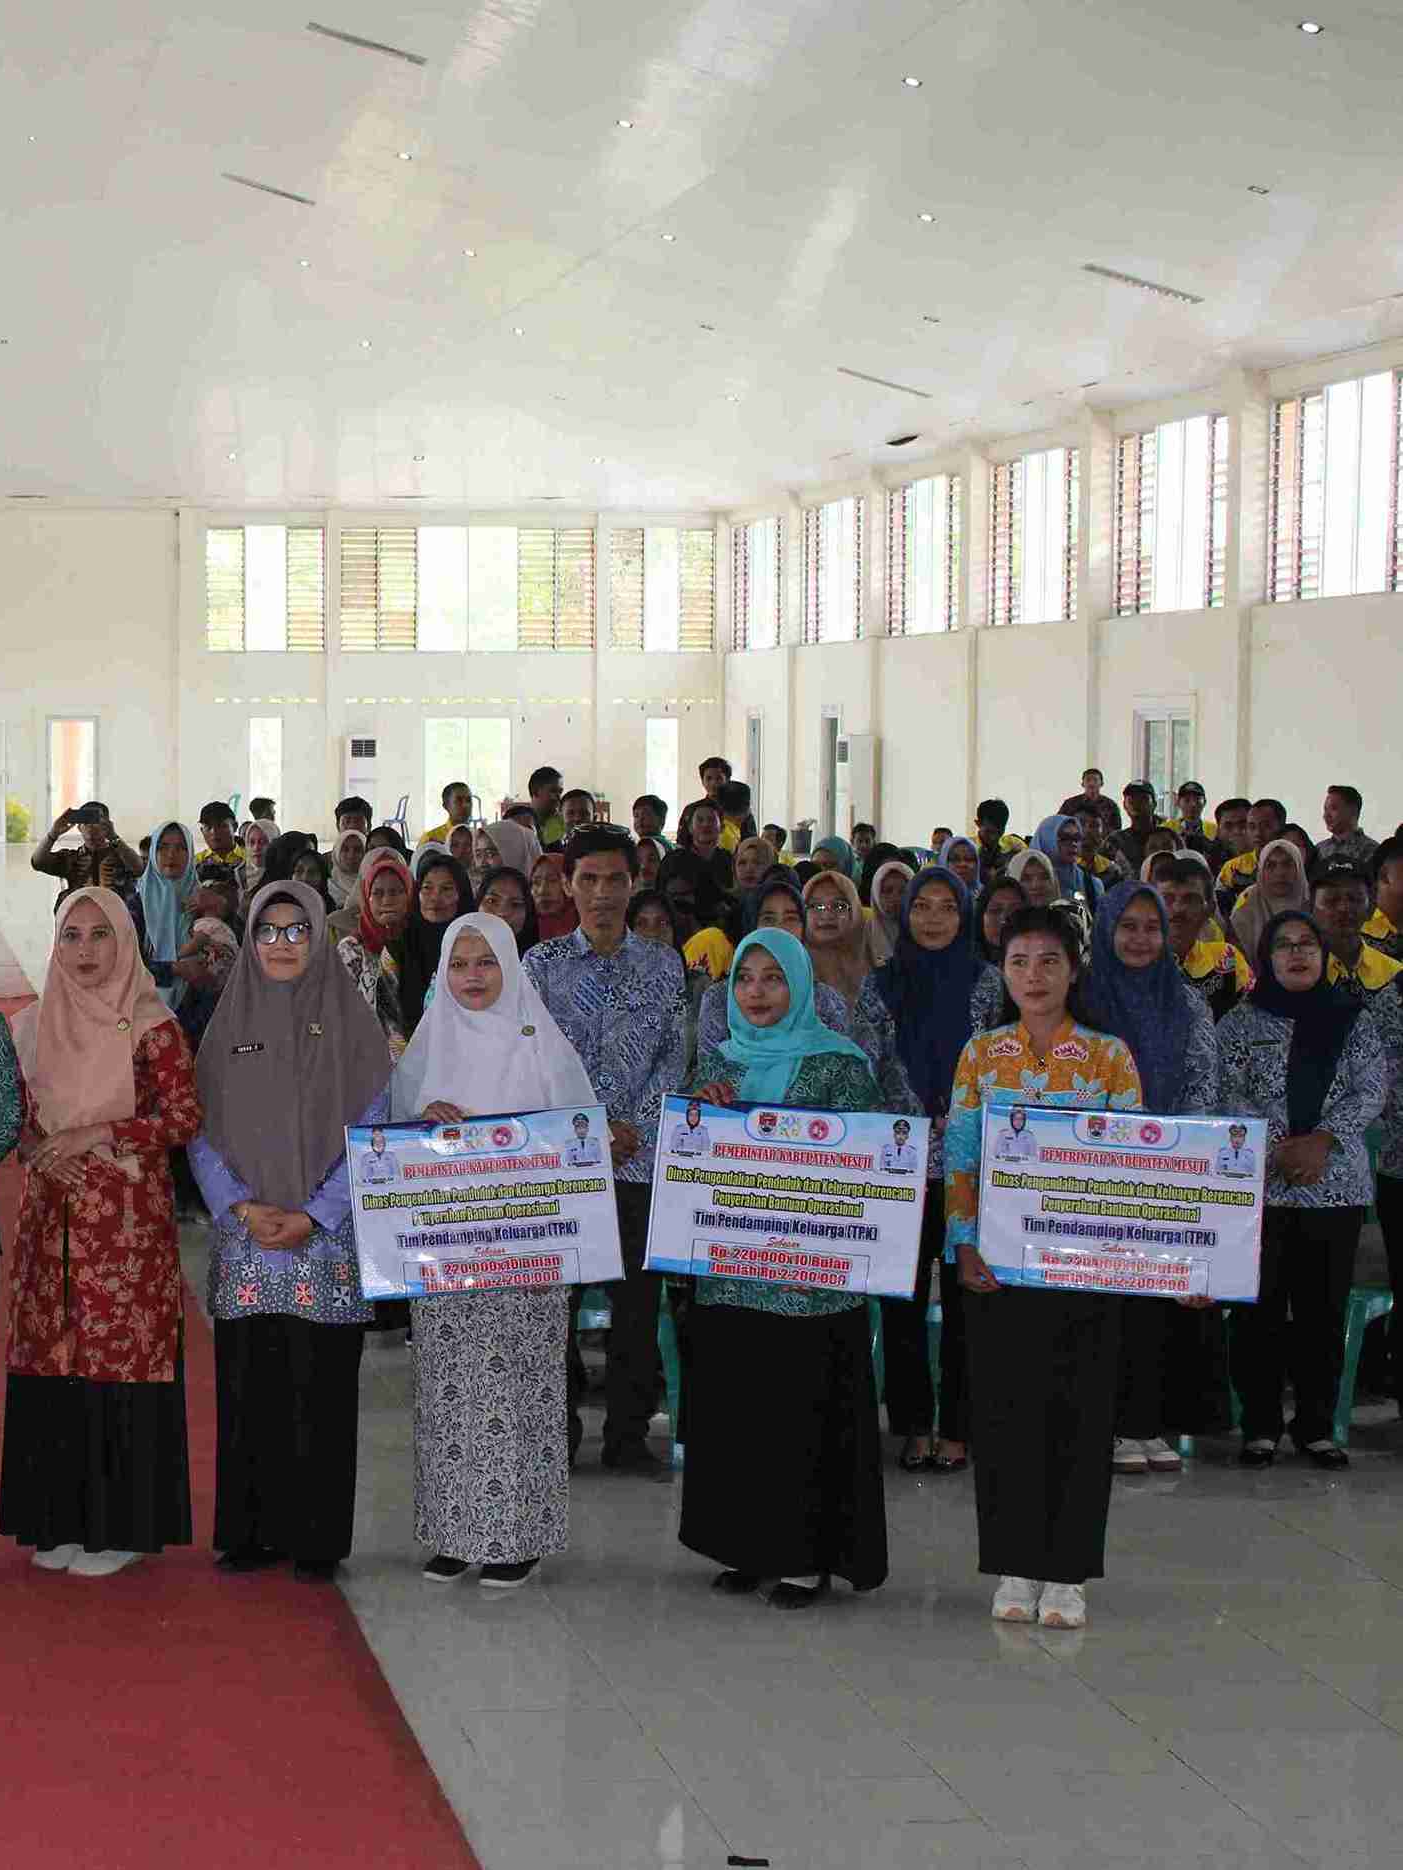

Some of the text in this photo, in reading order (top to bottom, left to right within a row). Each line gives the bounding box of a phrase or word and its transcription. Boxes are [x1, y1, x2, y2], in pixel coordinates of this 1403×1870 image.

[777, 1148, 836, 1167] KABUPATEN
[363, 1178, 606, 1210] Dinas Pengendalian Penduduk dan Keluarga Berencana
[667, 1165, 915, 1202] Dinas Pengendalian Penduduk dan Keluarga Berencana
[992, 1170, 1254, 1206] Dinas Pengendalian Penduduk dan Keluarga Berencana
[505, 1200, 559, 1219] Operasional
[713, 1189, 864, 1217] Penyerahan Bantuan Operasional
[1042, 1195, 1099, 1215] Penyerahan
[1141, 1202, 1200, 1222] Operasional
[398, 1221, 577, 1248] Tim Pendamping Keluarga (TPK)
[695, 1211, 877, 1240] Tim Pendamping Keluarga (TPK)
[1024, 1217, 1215, 1245] Tim Pendamping Keluarga (TPK)
[711, 1262, 757, 1277] Jumlah
[811, 1255, 849, 1270] Bulan
